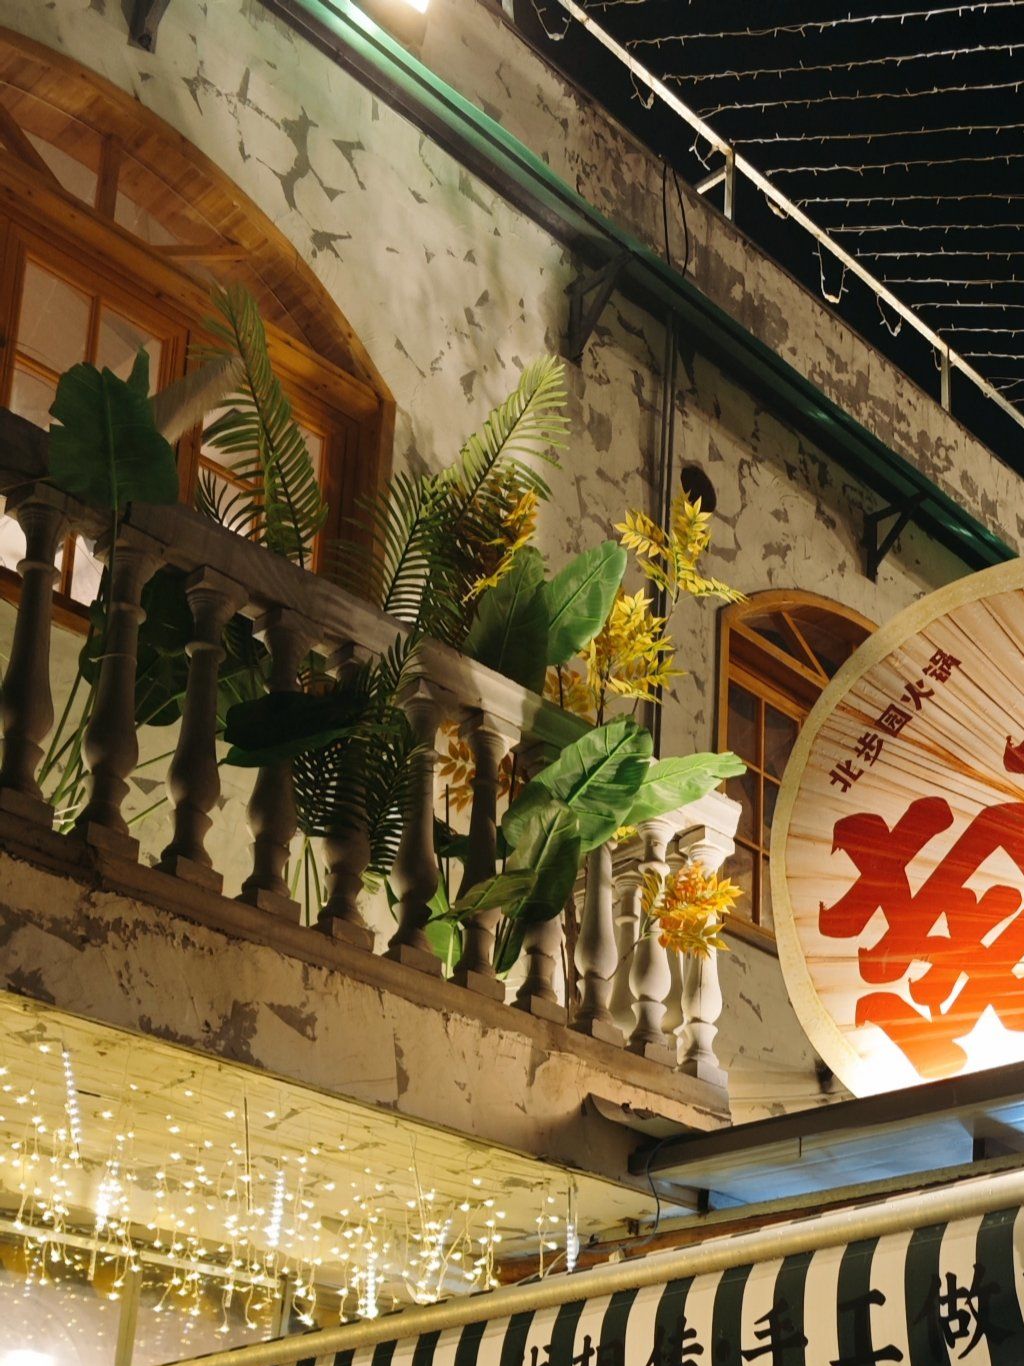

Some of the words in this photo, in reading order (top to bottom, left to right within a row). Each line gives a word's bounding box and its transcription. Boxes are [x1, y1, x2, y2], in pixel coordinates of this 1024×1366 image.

[829, 648, 963, 793] 北步园火锅
